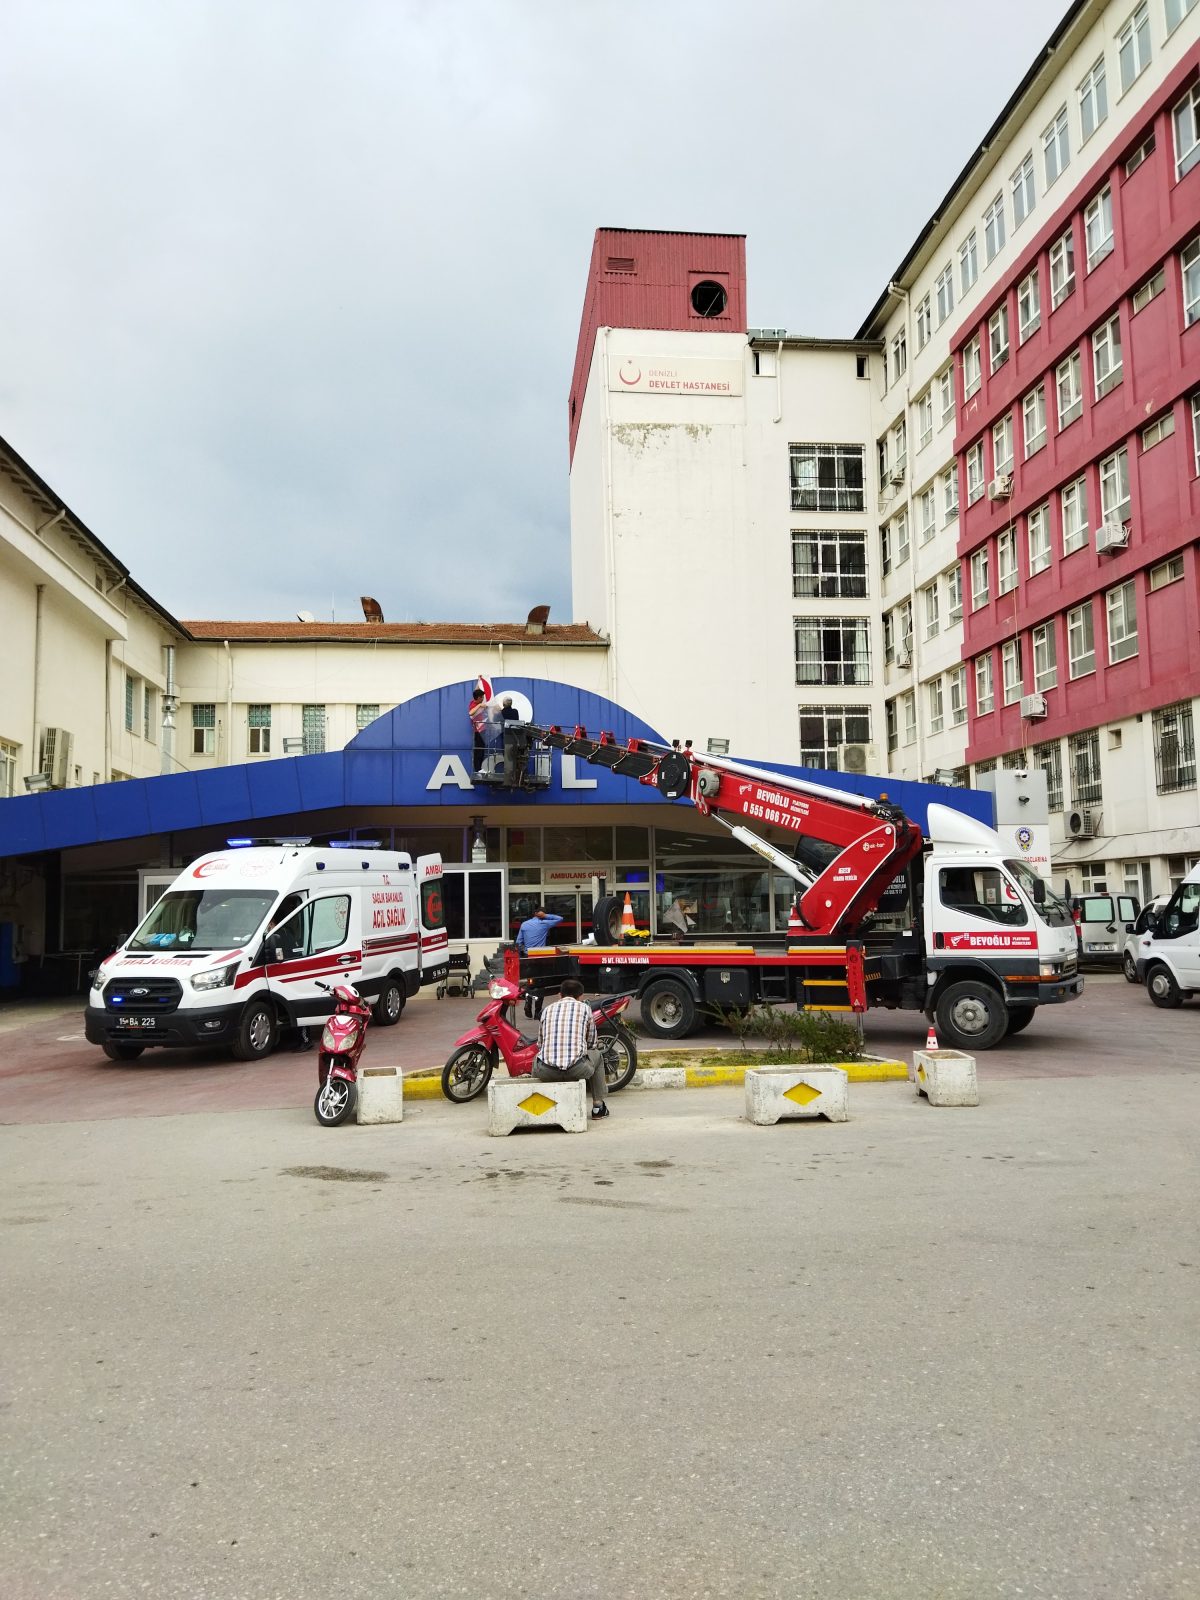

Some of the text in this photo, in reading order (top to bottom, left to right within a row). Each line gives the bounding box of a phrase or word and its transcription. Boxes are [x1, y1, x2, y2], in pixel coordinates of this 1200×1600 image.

[649, 380, 730, 391] DEVLET HASTANESİ
[756, 788, 790, 808] BEYOĞLU
[743, 801, 802, 829] 0 555 066 77 77
[425, 865, 443, 876] AMBU
[550, 872, 586, 880] AMBULANS
[371, 891, 404, 904] SAĞLIK BAKANLIĞI
[386, 906, 406, 928] SAĞLIK
[969, 934, 1011, 946] BEYOĞLU
[141, 1018, 156, 1026] 225
